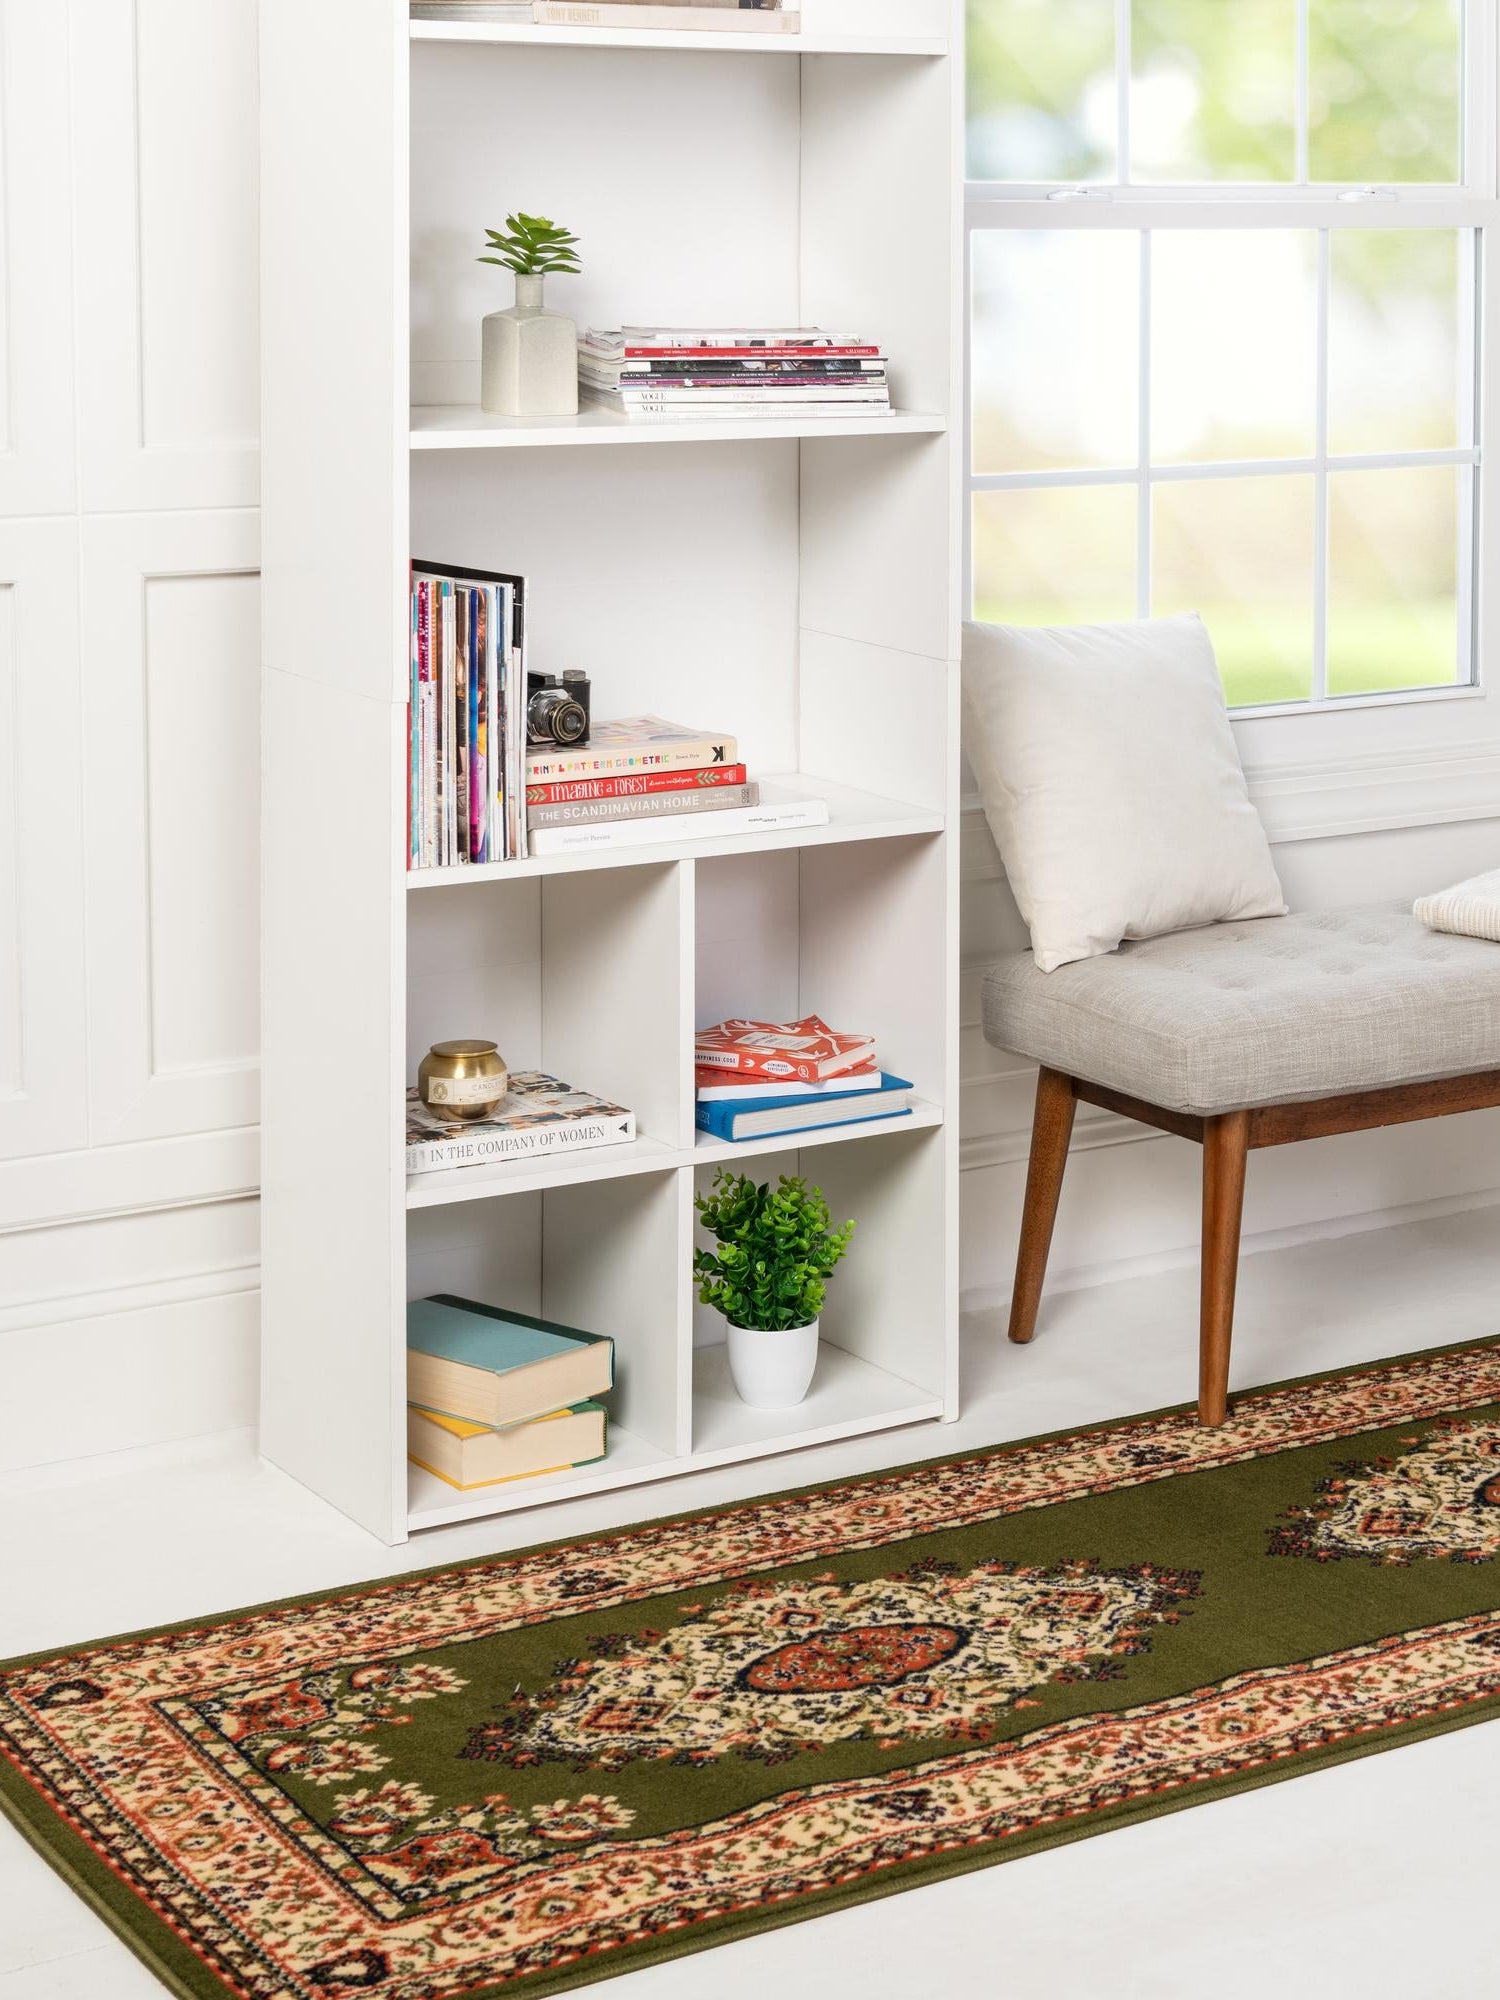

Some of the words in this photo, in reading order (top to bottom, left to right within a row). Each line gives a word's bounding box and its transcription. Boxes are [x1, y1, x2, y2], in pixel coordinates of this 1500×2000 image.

[526, 764, 556, 775] PRINT
[567, 759, 612, 771] PATTERN
[615, 754, 670, 768] GEOMETRIC
[614, 776, 649, 796] FOREST
[540, 810, 560, 821] THE
[563, 799, 659, 819] SCANDINAVIAN
[663, 795, 700, 809] HOME
[430, 1149, 444, 1162] IN
[447, 1144, 474, 1159] THE
[477, 1134, 537, 1154] COMPANY
[539, 1132, 556, 1147] OF
[558, 1125, 605, 1143] WOMEN
